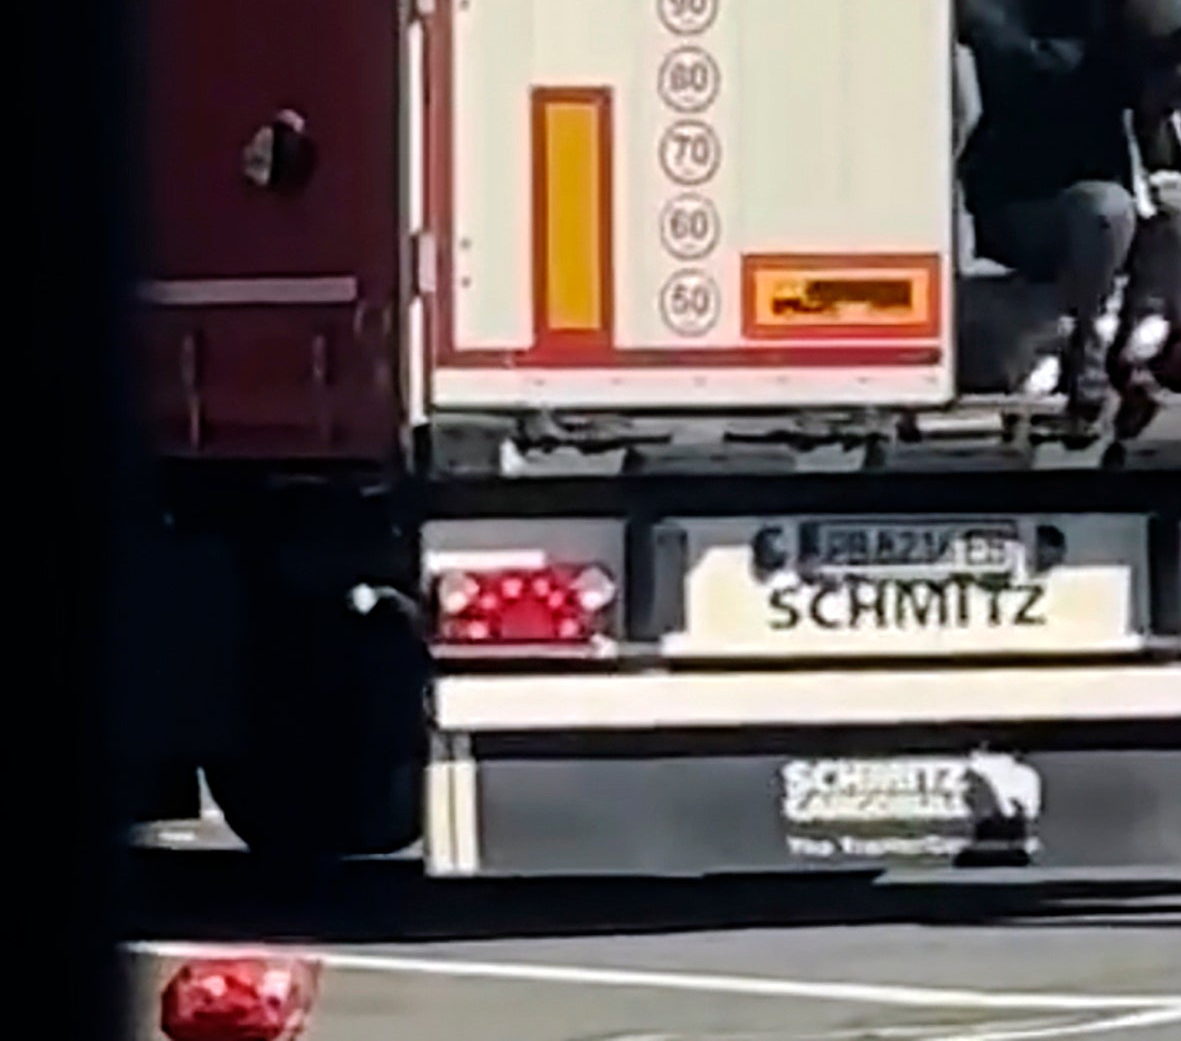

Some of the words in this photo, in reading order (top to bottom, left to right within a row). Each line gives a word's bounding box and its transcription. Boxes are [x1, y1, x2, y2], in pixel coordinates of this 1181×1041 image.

[669, 61, 709, 93] 80
[671, 134, 709, 166] 70
[670, 210, 709, 240] 60
[768, 576, 1047, 630] SCHMITZ
